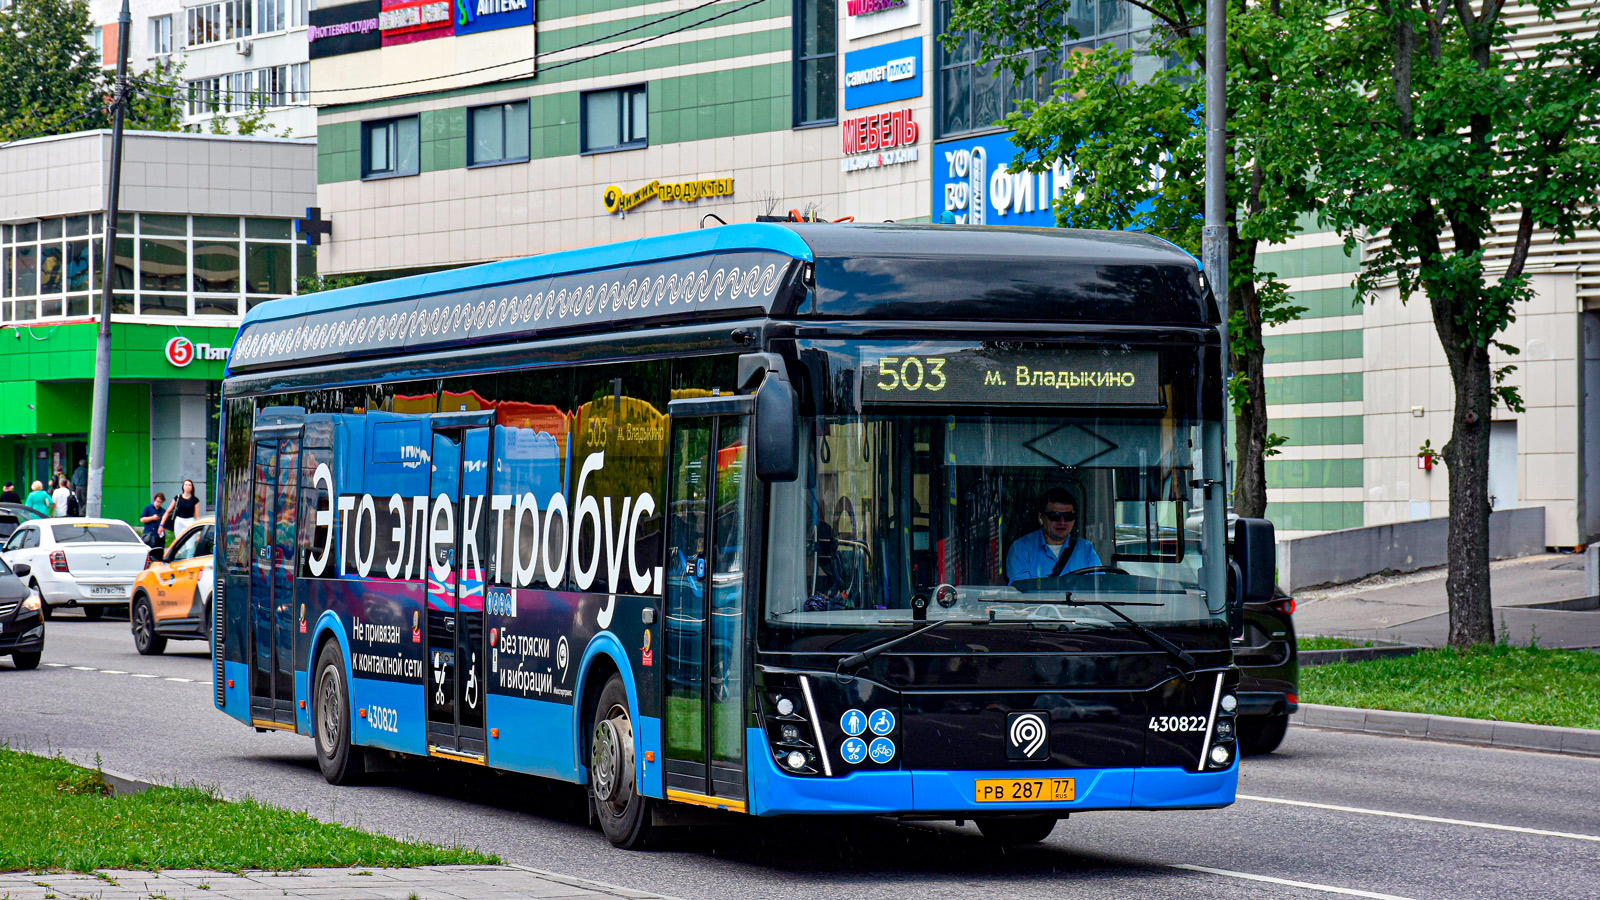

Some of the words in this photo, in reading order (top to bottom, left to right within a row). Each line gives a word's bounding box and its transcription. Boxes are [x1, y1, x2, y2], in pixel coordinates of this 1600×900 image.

[350, 18, 379, 34] СТУДИЯ
[842, 108, 919, 155] МЕБЕЛЬ
[657, 179, 730, 201] ПРОДУКТЫ
[990, 160, 1093, 216] ФИТН
[876, 356, 947, 392] 503
[984, 370, 1007, 386] м.
[1015, 365, 1135, 389] Владыкино
[586, 416, 608, 448] 503
[308, 462, 376, 579] Это
[385, 450, 663, 630] электробус.
[352, 616, 363, 641] Не
[365, 623, 400, 647] привязан
[500, 627, 517, 655] Без
[518, 635, 550, 662] тряски
[359, 651, 402, 677] контактной
[404, 658, 423, 678] сети
[500, 668, 506, 688] и
[507, 662, 552, 697] вибраций
[367, 704, 398, 733] 430822
[1149, 716, 1207, 732] 430822
[1012, 781, 1043, 799] 287
[1054, 780, 1069, 793] 77
